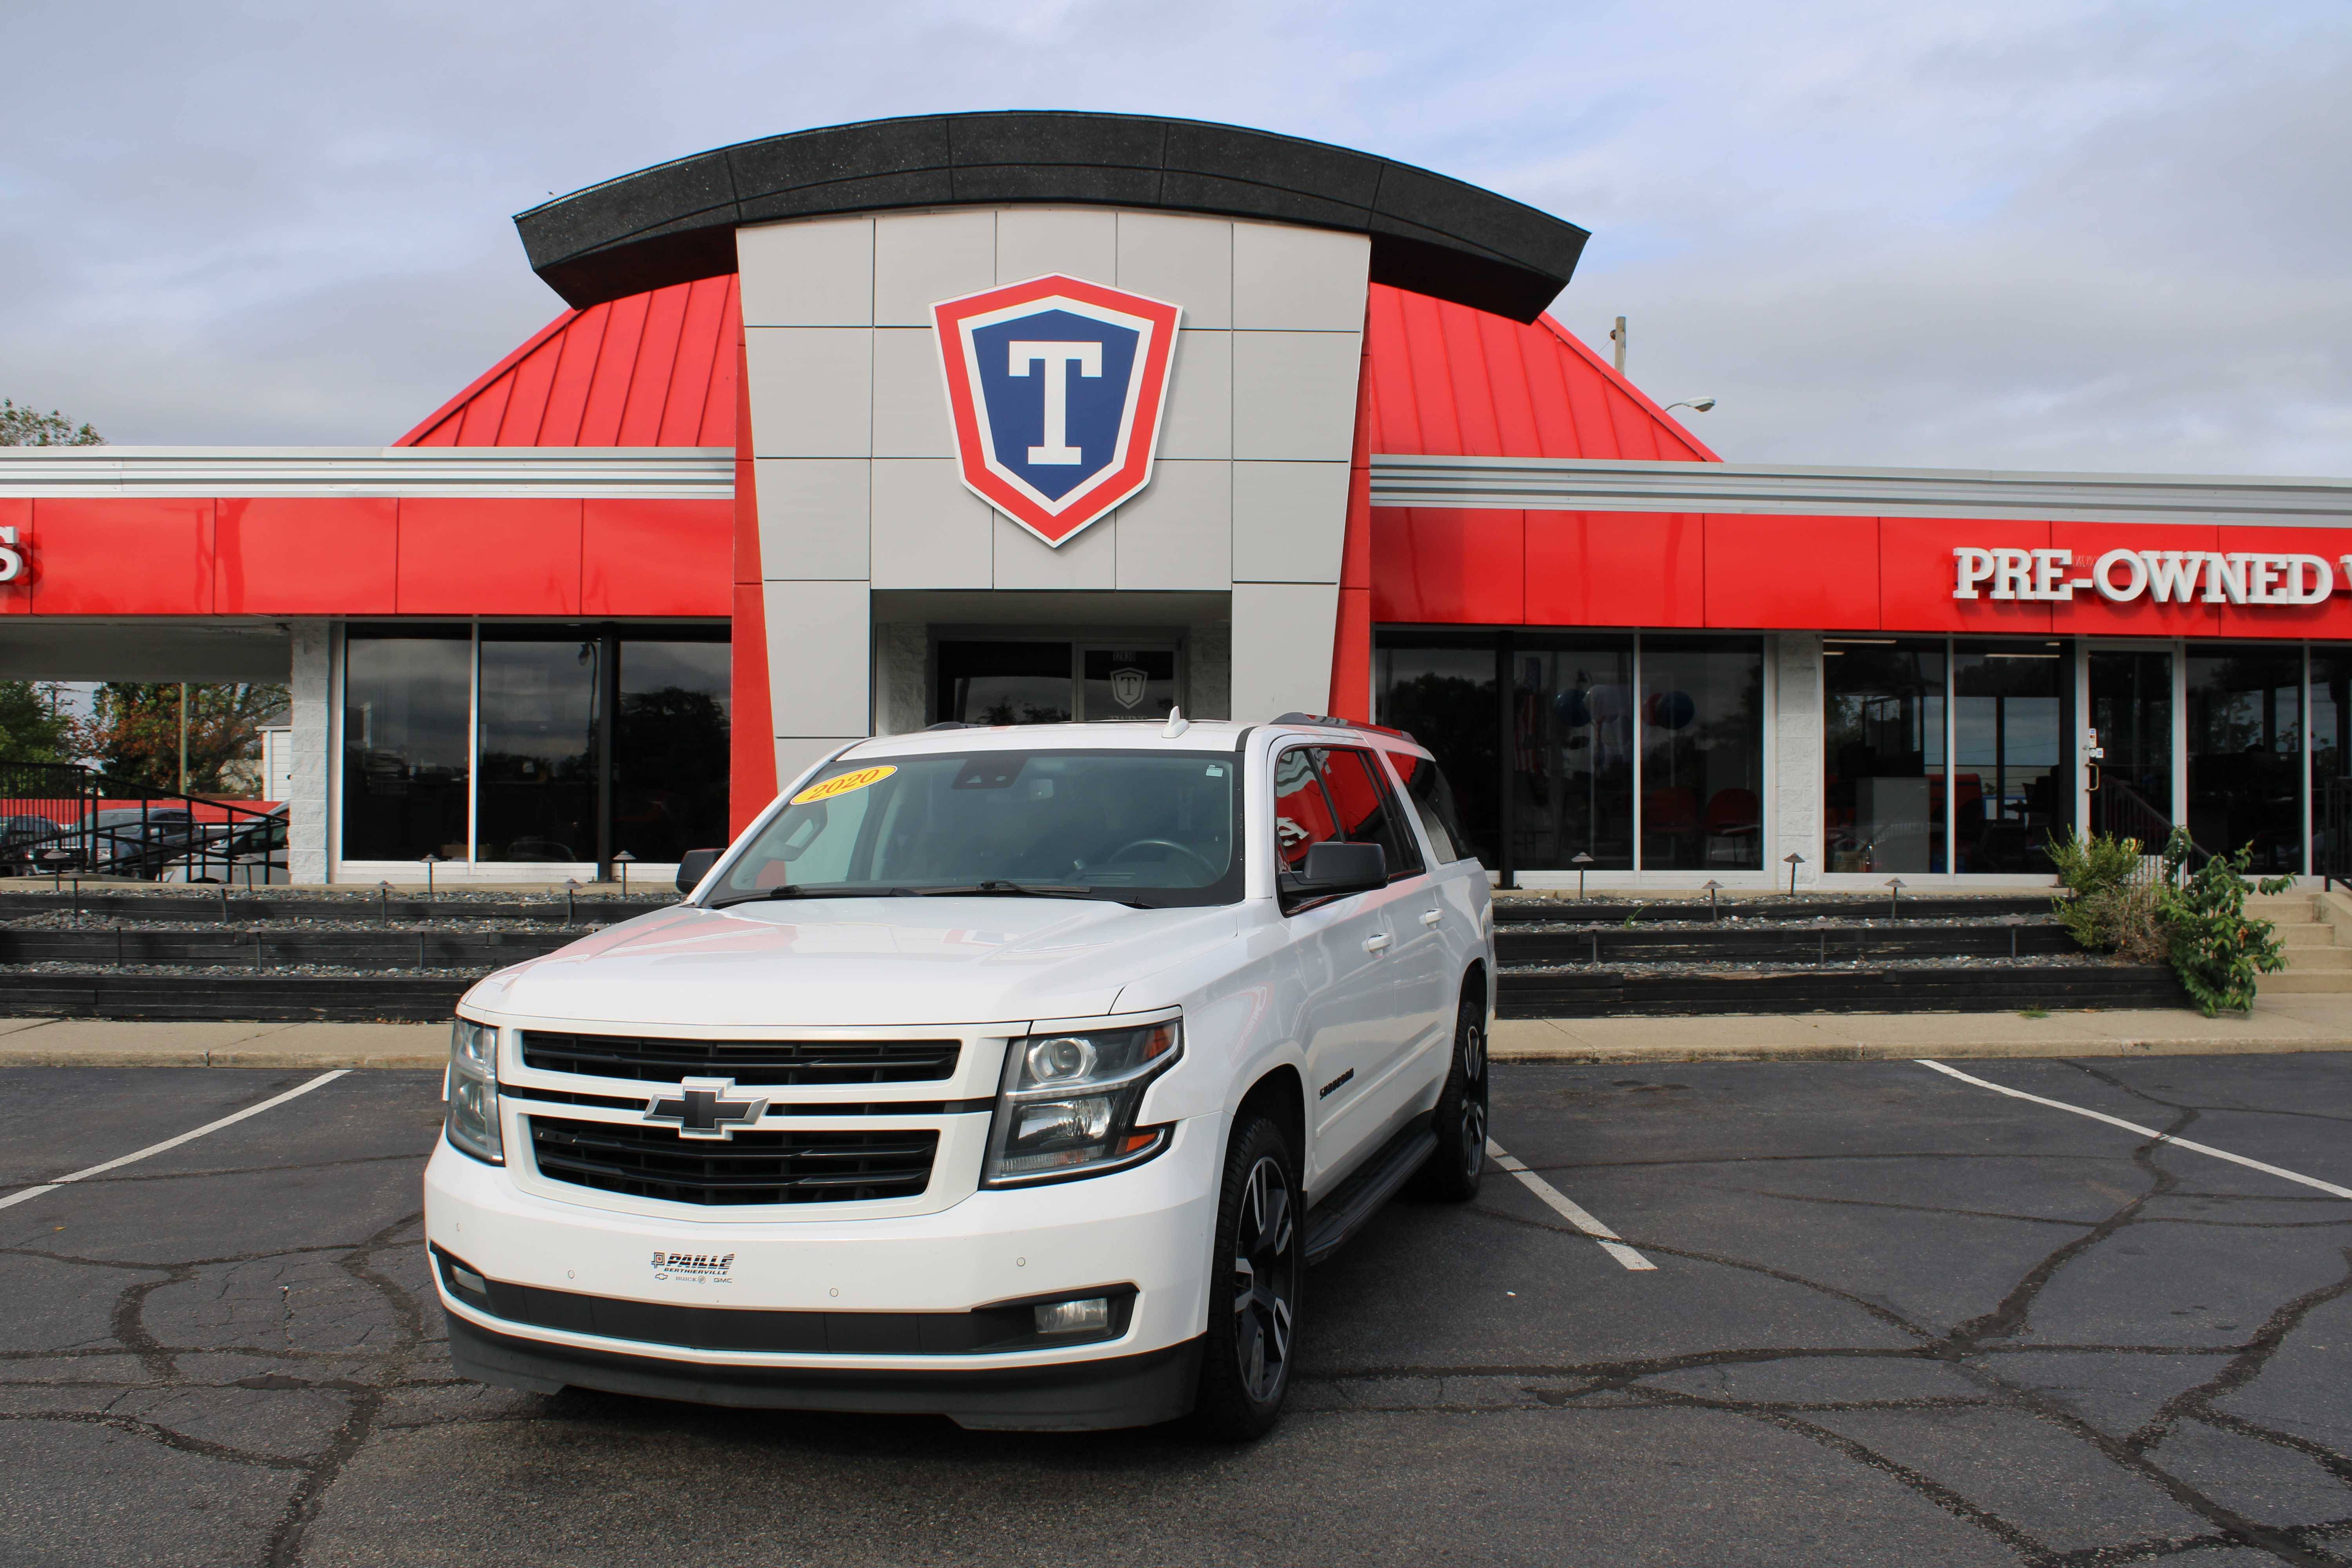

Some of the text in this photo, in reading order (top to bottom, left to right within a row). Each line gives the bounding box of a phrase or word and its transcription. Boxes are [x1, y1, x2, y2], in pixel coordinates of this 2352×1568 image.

[1009, 341, 1102, 465] T
[1953, 547, 2334, 604] PRE-OWNED
[1121, 677, 1137, 695] T
[806, 769, 879, 800] 2020
